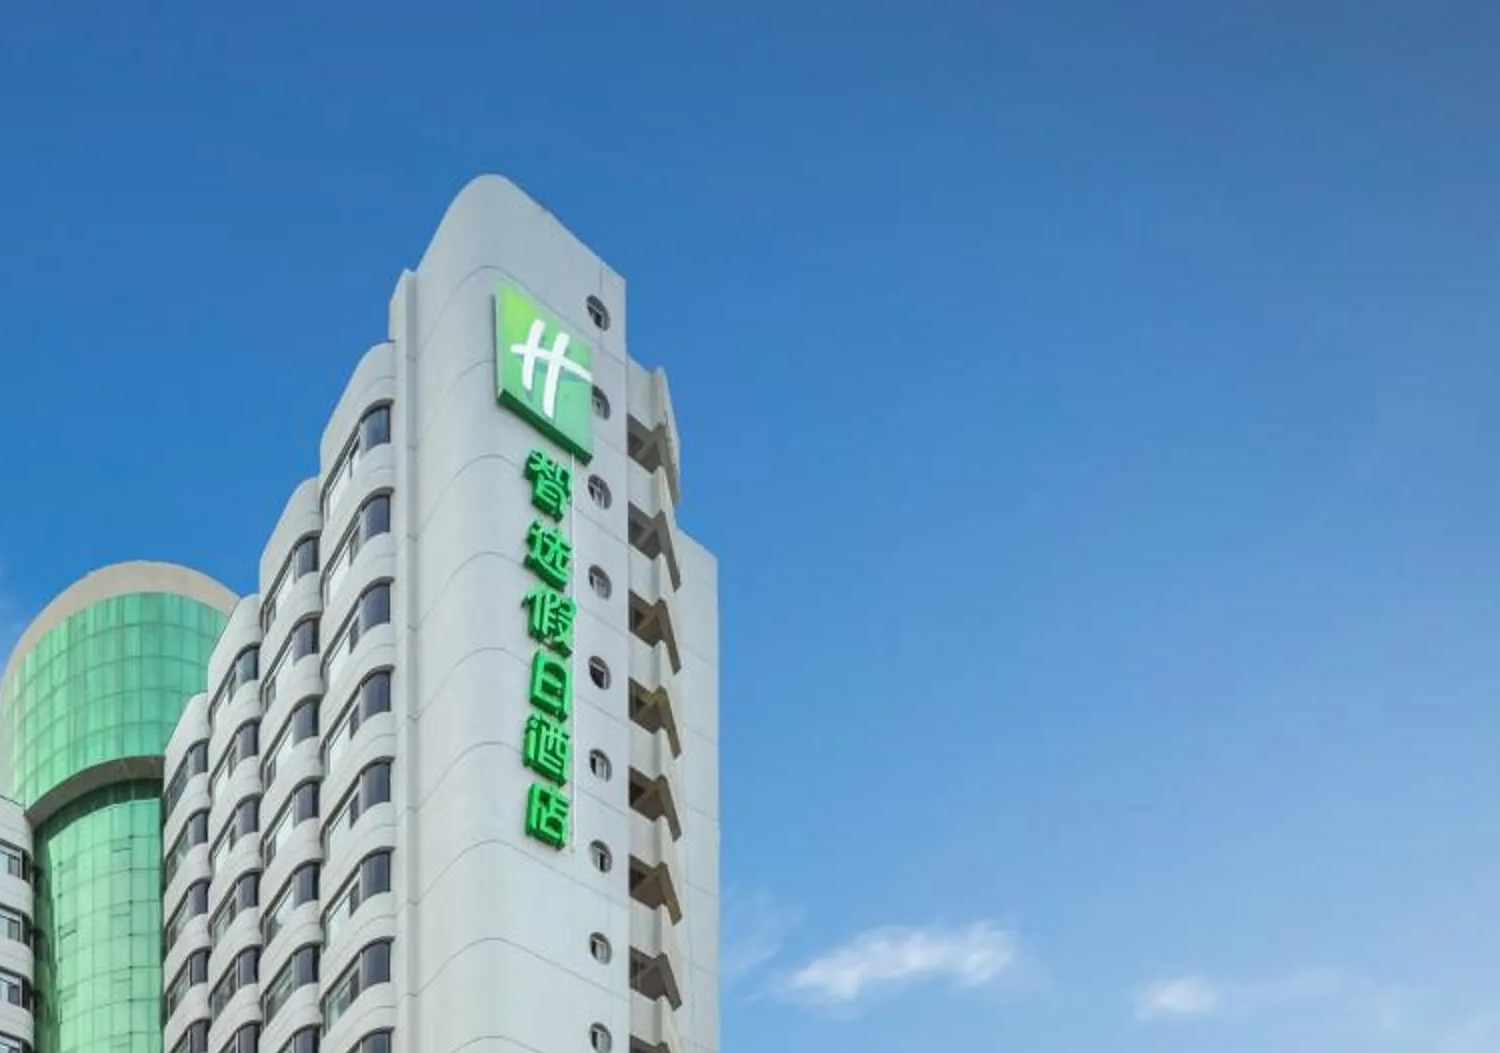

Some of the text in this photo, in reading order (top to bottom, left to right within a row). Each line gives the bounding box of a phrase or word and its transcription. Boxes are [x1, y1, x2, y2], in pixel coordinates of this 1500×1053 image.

[523, 448, 576, 851] 智选假日酒店
